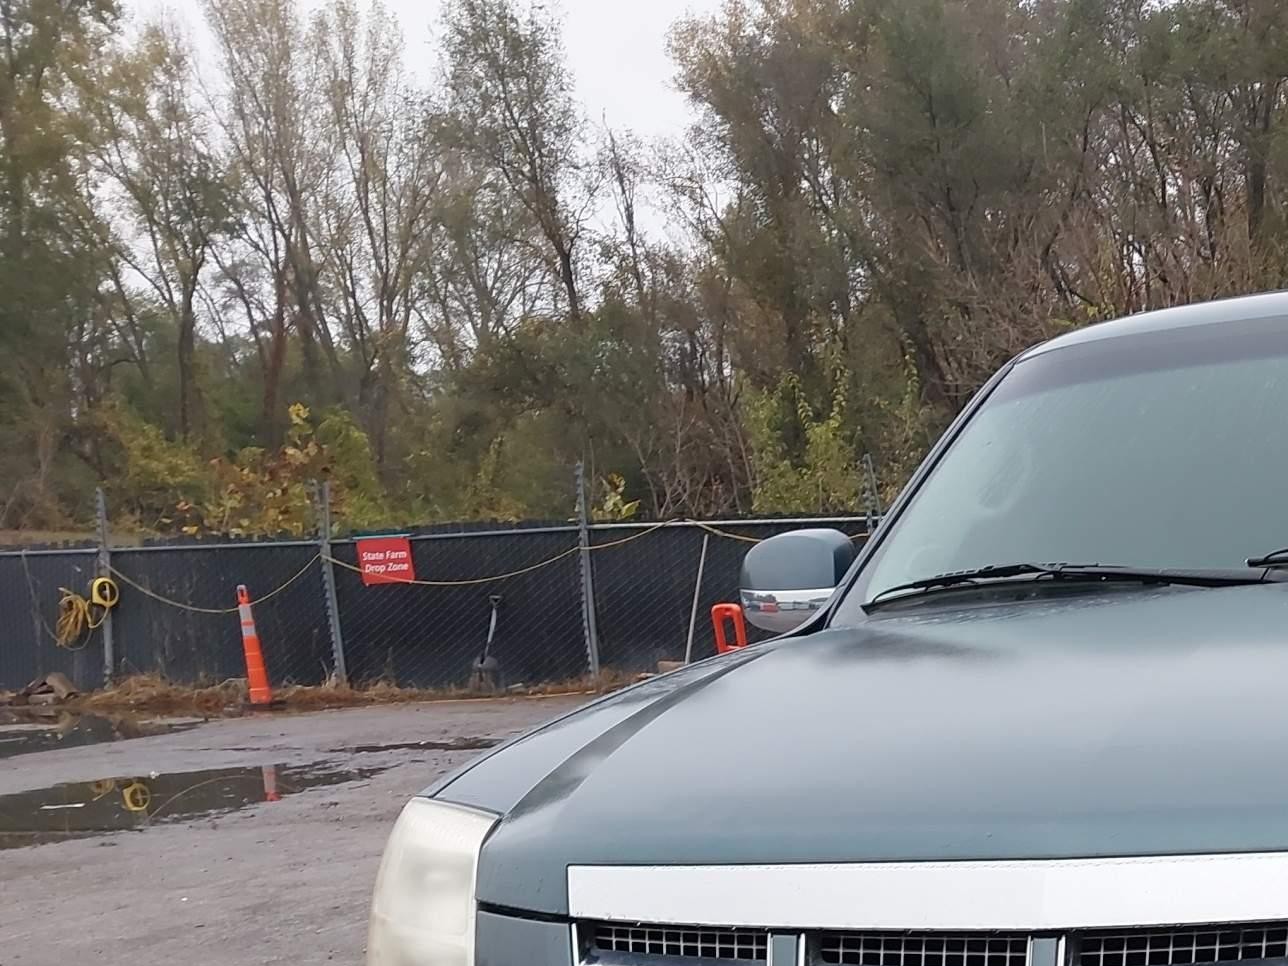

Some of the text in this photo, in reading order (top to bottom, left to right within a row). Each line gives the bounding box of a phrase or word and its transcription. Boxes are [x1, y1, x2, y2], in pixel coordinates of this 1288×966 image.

[362, 550, 407, 561] State Farm
[365, 562, 409, 574] Drop Zone
